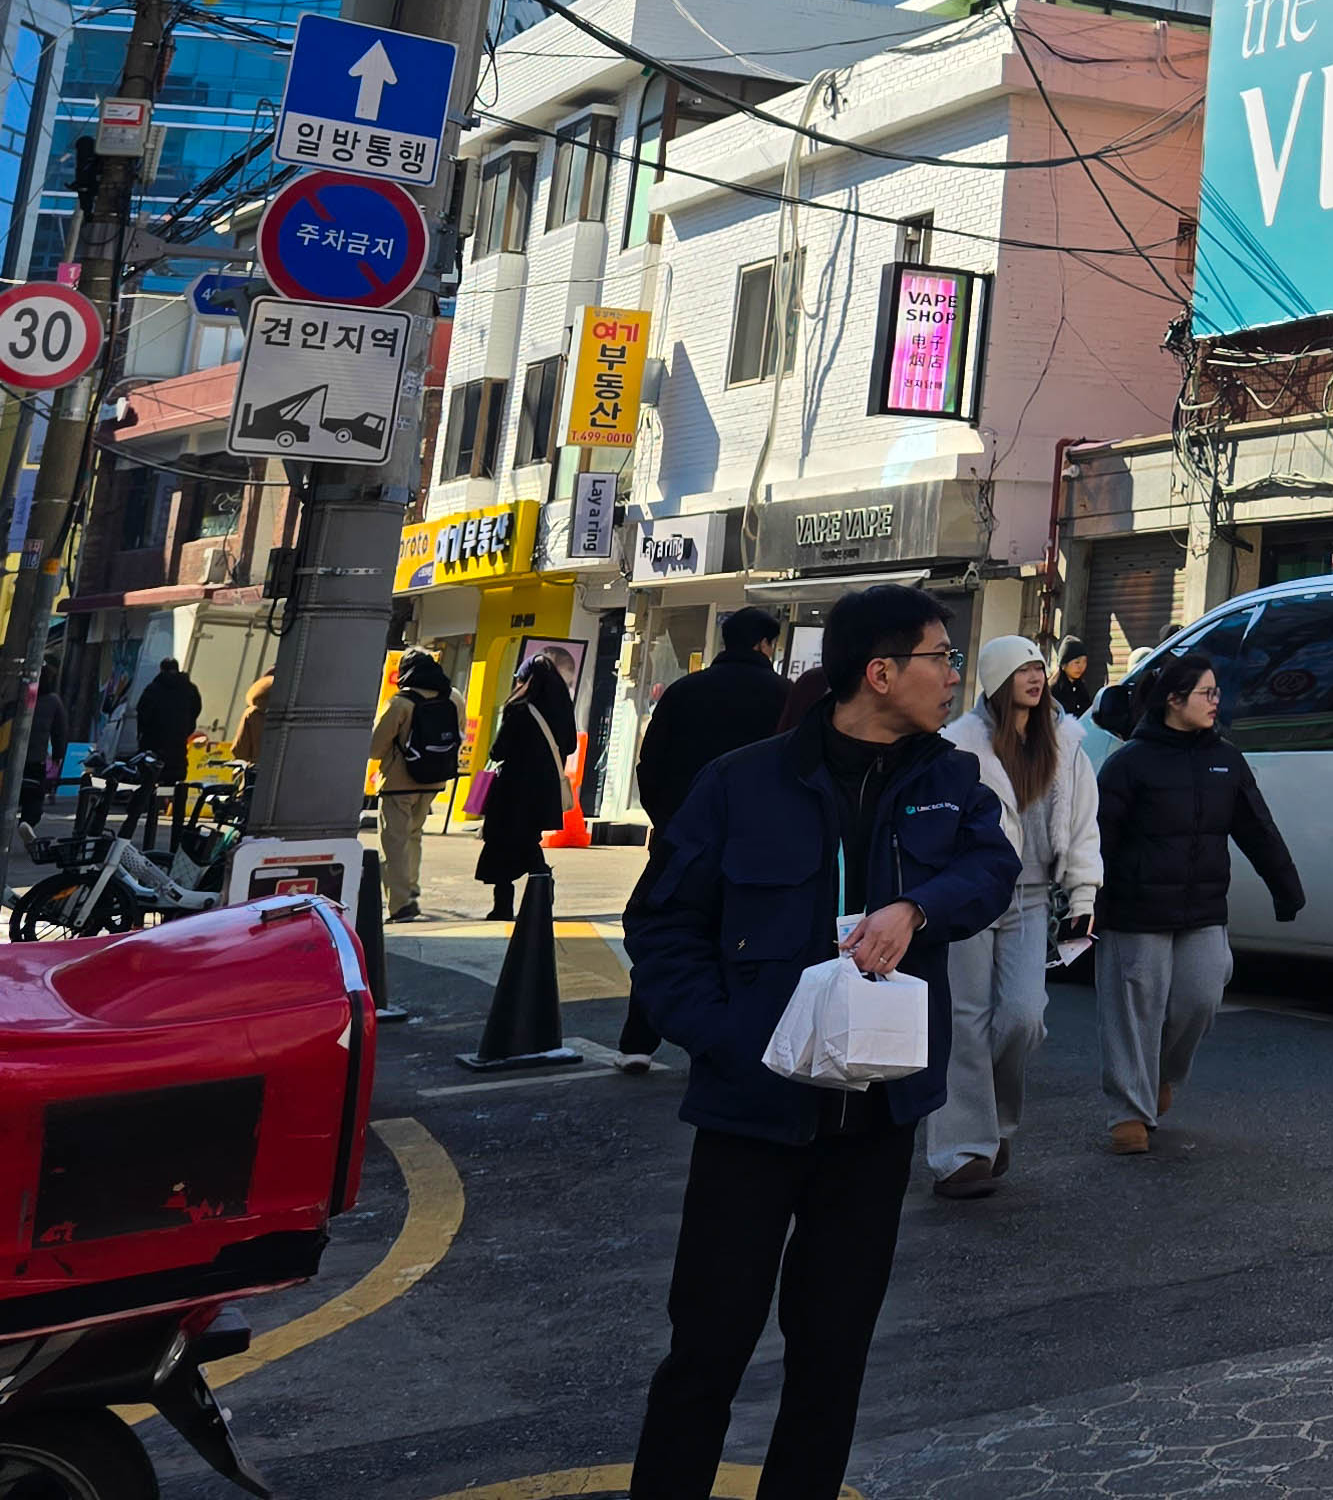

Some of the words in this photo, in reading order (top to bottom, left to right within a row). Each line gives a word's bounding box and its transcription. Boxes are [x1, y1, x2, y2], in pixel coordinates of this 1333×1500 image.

[297, 122, 427, 175] 일방통행
[296, 222, 395, 260] 주차금지
[906, 309, 957, 324] SHOP
[908, 291, 958, 308] VAPE
[8, 306, 72, 362] 30
[260, 316, 400, 358] 견인지역
[592, 321, 640, 343] 여기
[589, 343, 627, 429] 부동산
[571, 430, 633, 444] T.499-0010
[796, 509, 840, 545] VAPE
[845, 504, 894, 539] VAPE
